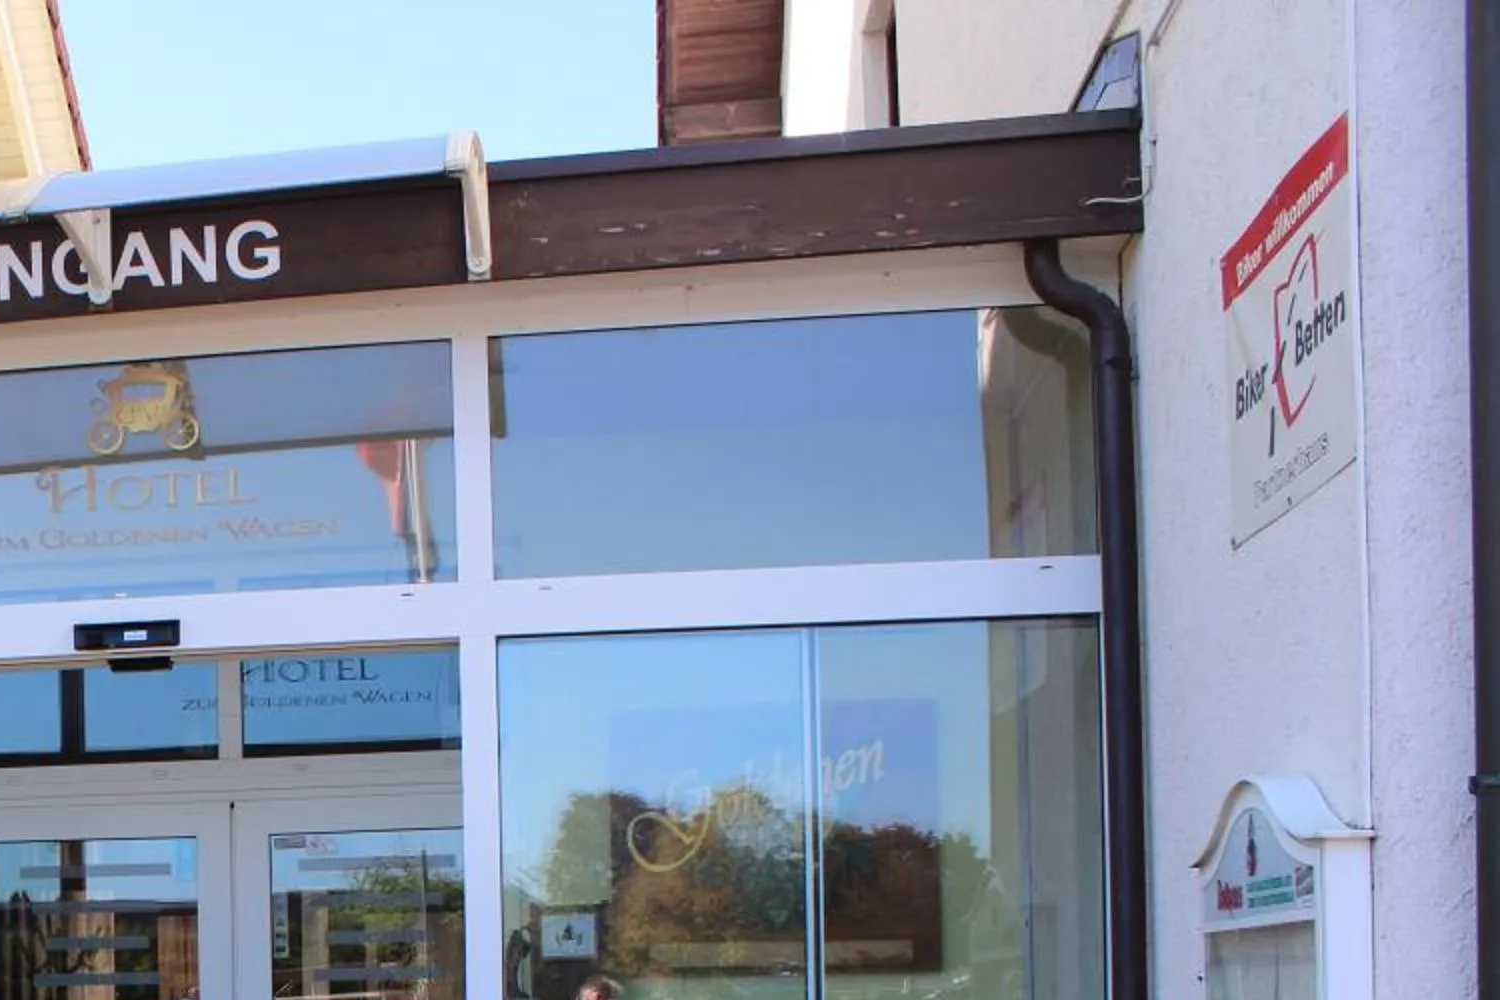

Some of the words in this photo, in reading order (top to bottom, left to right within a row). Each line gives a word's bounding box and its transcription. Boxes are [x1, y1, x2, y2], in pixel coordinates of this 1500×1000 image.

[1236, 242, 1264, 287] Biker
[1265, 161, 1332, 254] willkommen
[1235, 362, 1269, 421] Biker
[1295, 290, 1345, 368] Betten
[36, 465, 258, 513] HOTEL
[39, 527, 209, 551] GOLDENEN
[217, 516, 340, 541] WAGEN
